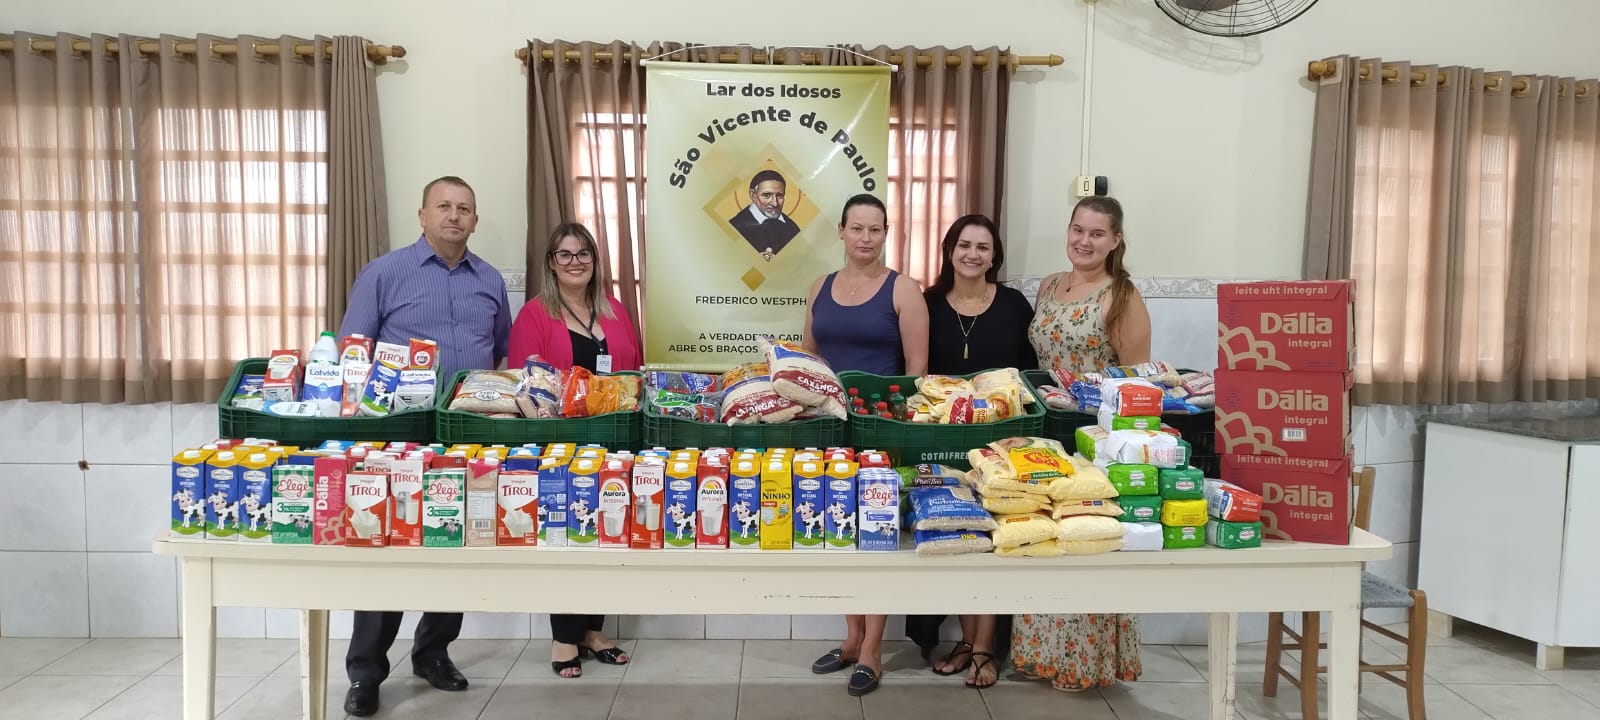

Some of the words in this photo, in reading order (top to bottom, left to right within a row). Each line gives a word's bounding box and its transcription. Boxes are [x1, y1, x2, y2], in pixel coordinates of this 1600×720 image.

[707, 83, 736, 97] Lar
[741, 83, 775, 98] dos
[781, 84, 841, 99] Idosos
[669, 147, 701, 189] São
[697, 105, 792, 145] Vicente
[799, 111, 828, 135] de
[831, 128, 876, 192] Paulo
[1235, 286, 1260, 295] leite
[1262, 286, 1281, 295] uht
[1283, 285, 1328, 296] integral
[695, 295, 758, 306] FREDERICO
[1260, 312, 1333, 334] Dália
[698, 332, 706, 340] A
[709, 333, 775, 341] VERDADEA
[1288, 338, 1332, 348] integral
[668, 344, 697, 353] ABRE
[699, 345, 714, 353] OS
[716, 345, 759, 355] BRAÇOS
[309, 369, 340, 377] Latvida
[345, 369, 368, 377] TIRO
[1257, 388, 1329, 411] Dália
[1284, 415, 1328, 425] integral
[1237, 455, 1262, 464] leite
[1264, 456, 1283, 466] uht
[1285, 457, 1329, 468] integral
[393, 473, 422, 483] TIROL
[349, 485, 384, 497] TIROL
[502, 485, 535, 497] TIROL
[762, 492, 791, 500] NINHO
[1263, 482, 1334, 508] Dália
[1289, 510, 1333, 521] integral
